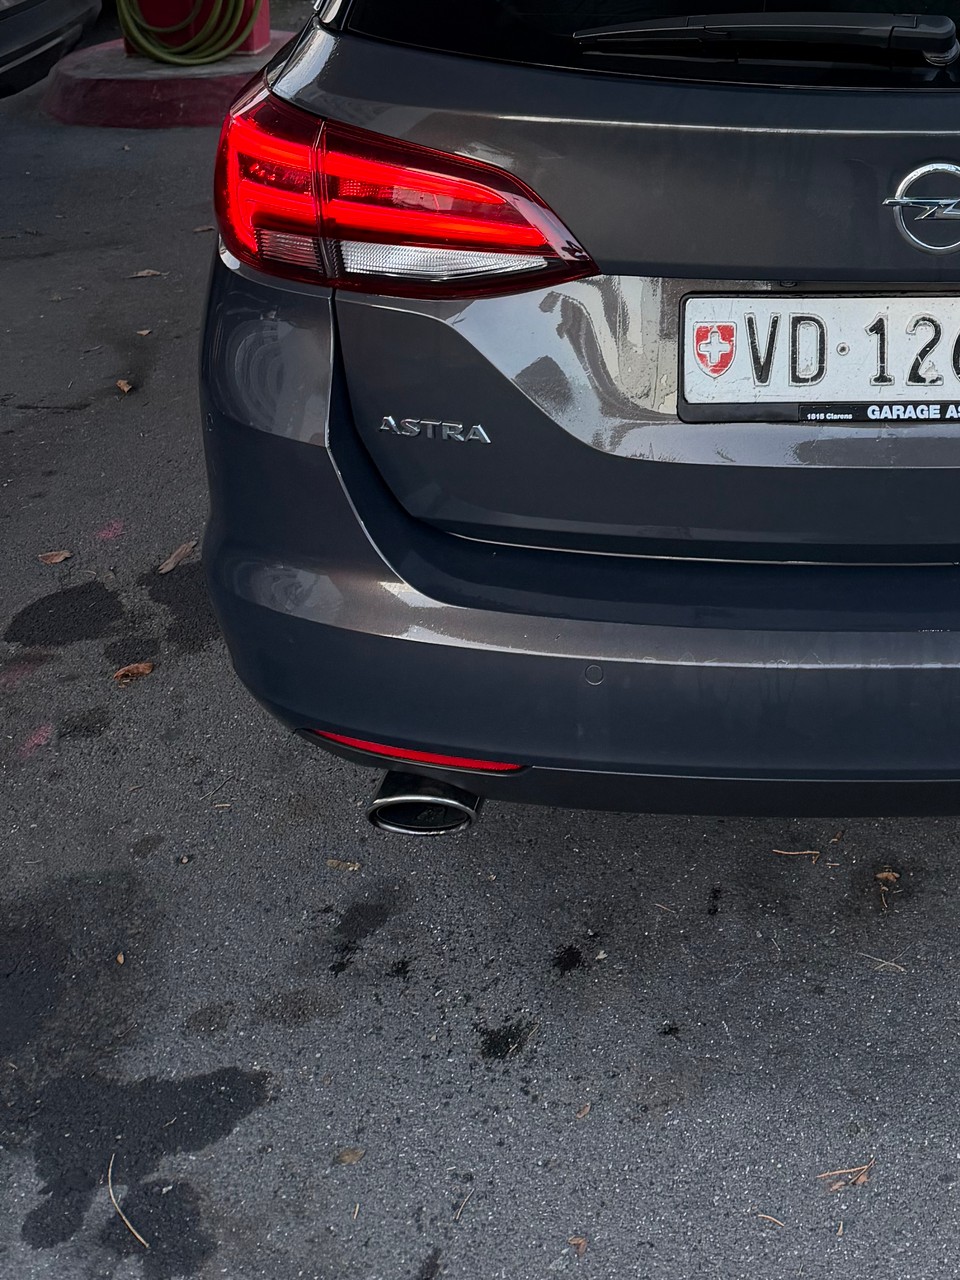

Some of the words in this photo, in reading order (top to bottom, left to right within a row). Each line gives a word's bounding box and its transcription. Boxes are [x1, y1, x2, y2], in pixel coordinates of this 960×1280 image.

[744, 312, 828, 387] VD
[825, 412, 853, 420] Clarens
[867, 405, 940, 419] GARAGE
[380, 416, 491, 443] ASTRA
